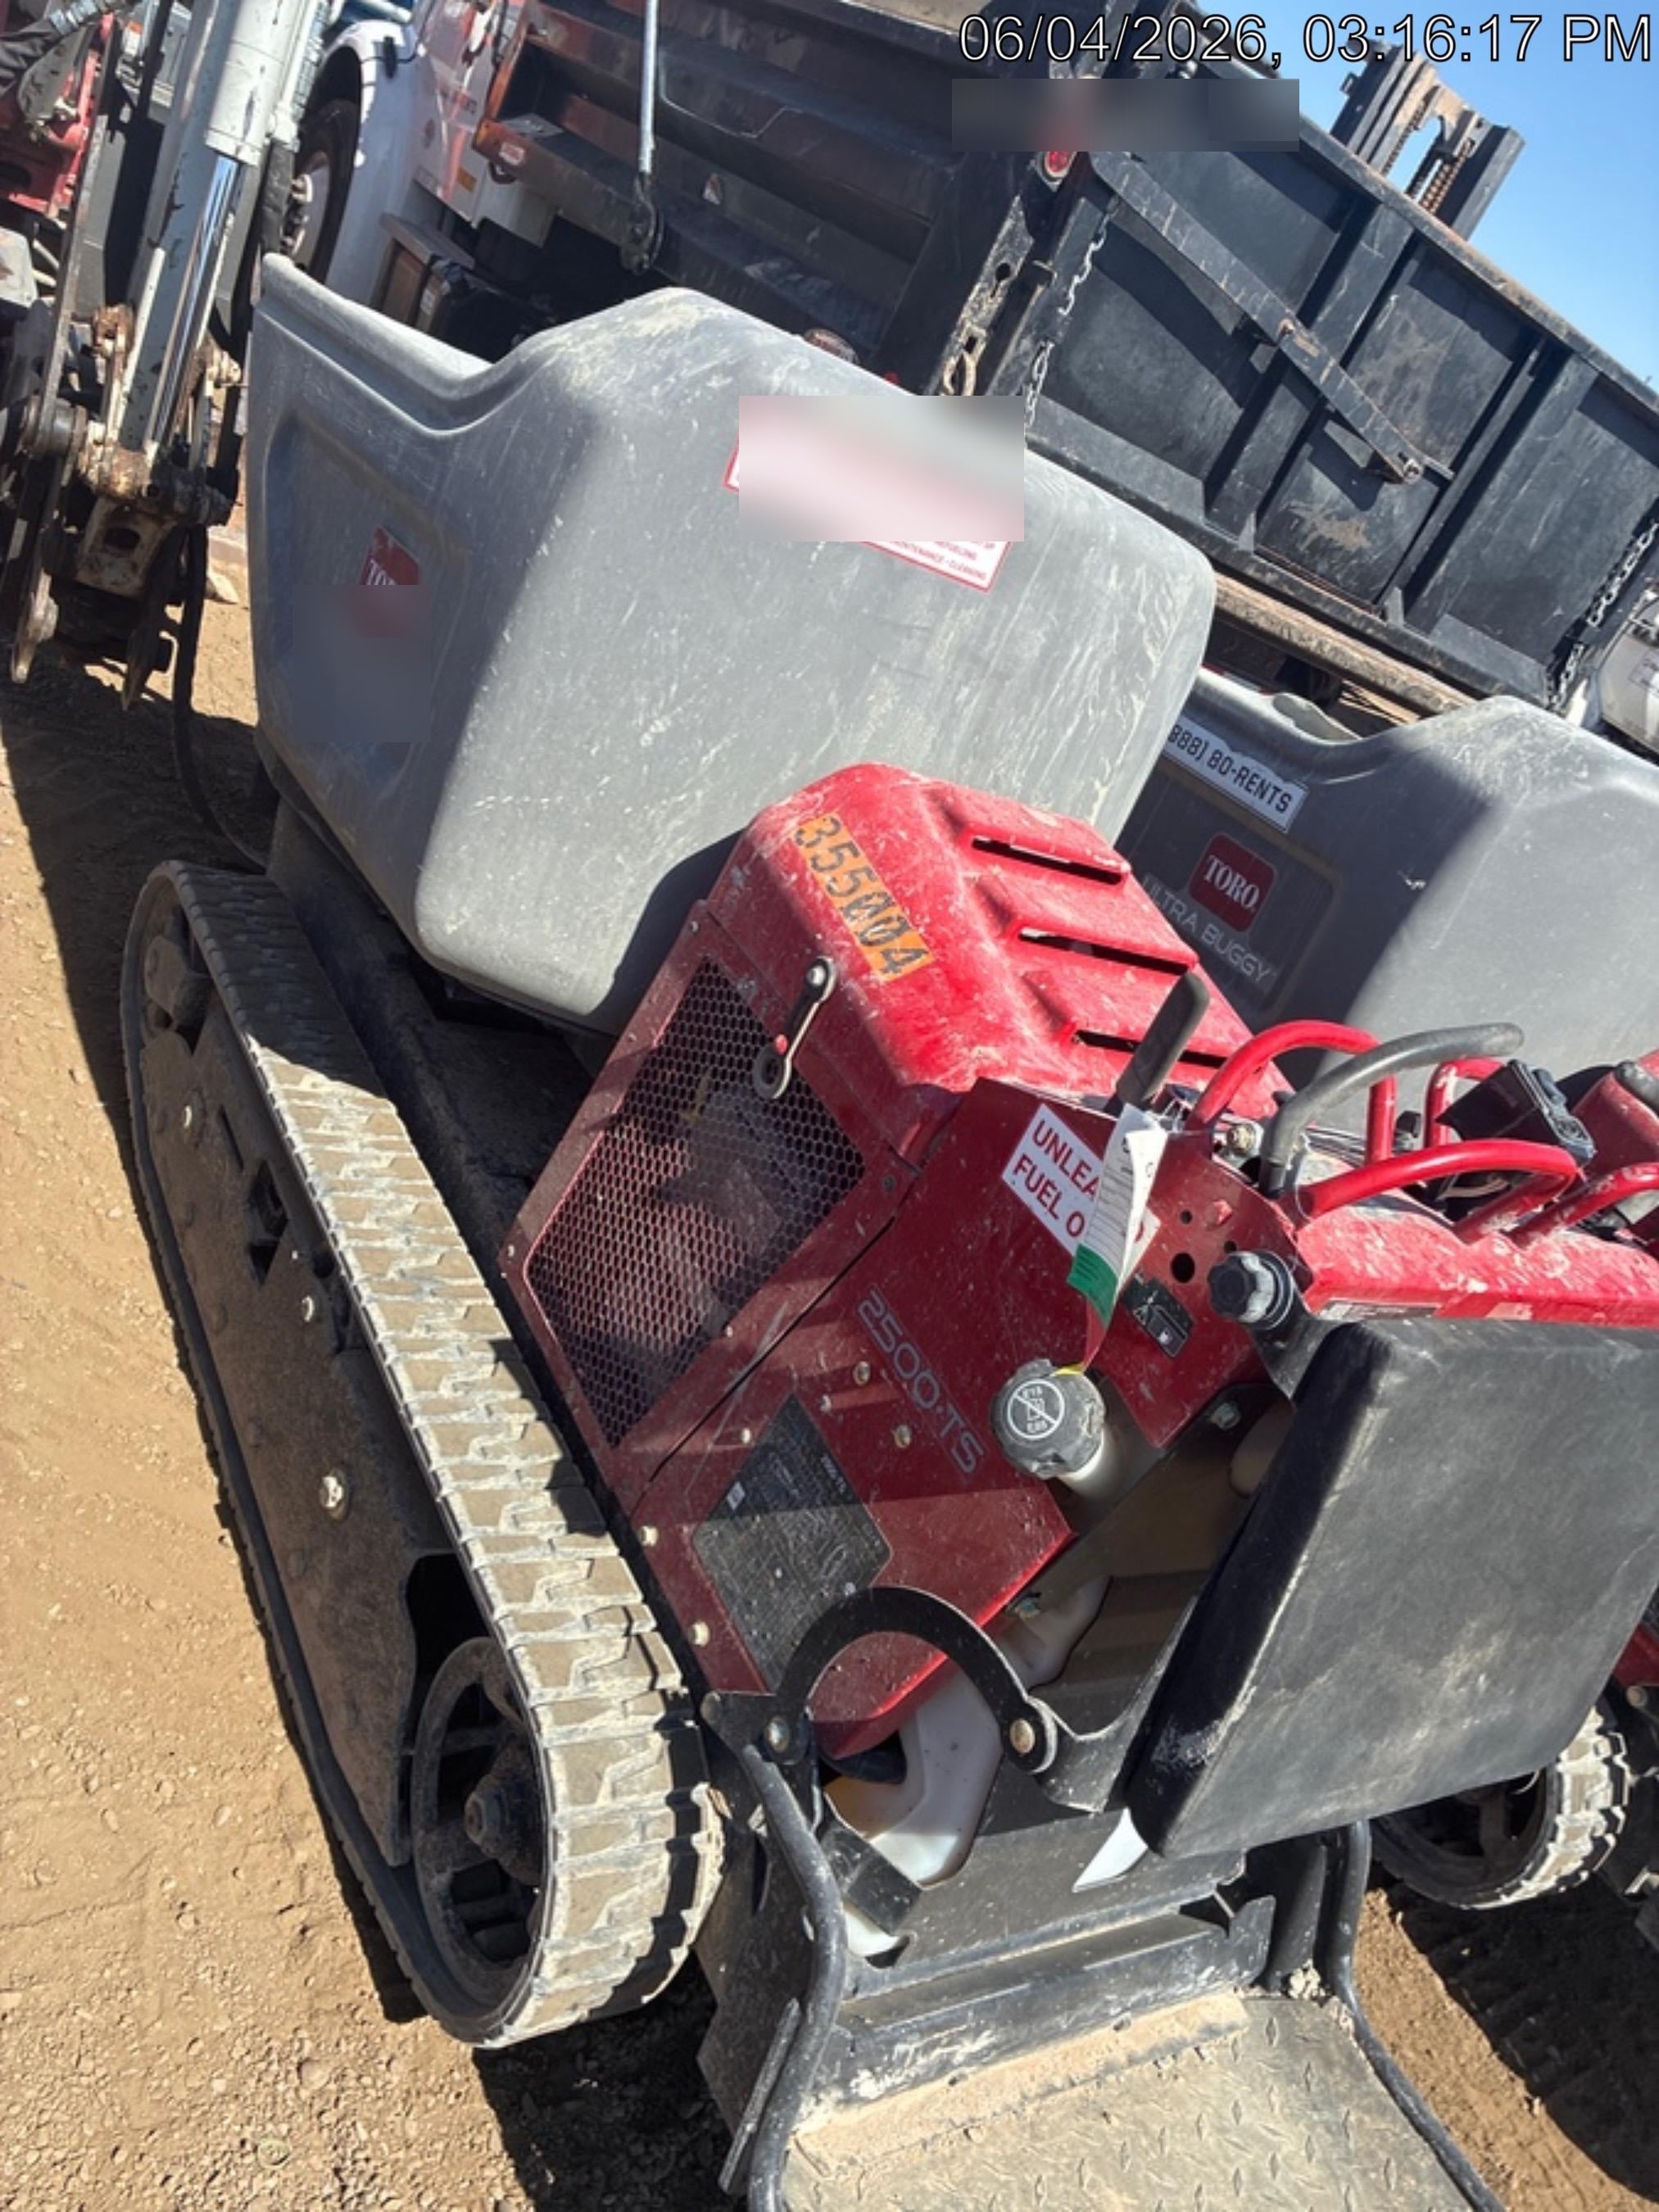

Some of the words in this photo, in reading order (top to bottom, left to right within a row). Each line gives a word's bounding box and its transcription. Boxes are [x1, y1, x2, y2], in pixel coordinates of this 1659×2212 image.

[1167, 724, 1209, 762] 888)
[794, 816, 929, 974] 355004
[1203, 854, 1261, 909] TORO
[1200, 922, 1271, 983] BUGGY
[1013, 1154, 1065, 1221] FUEL
